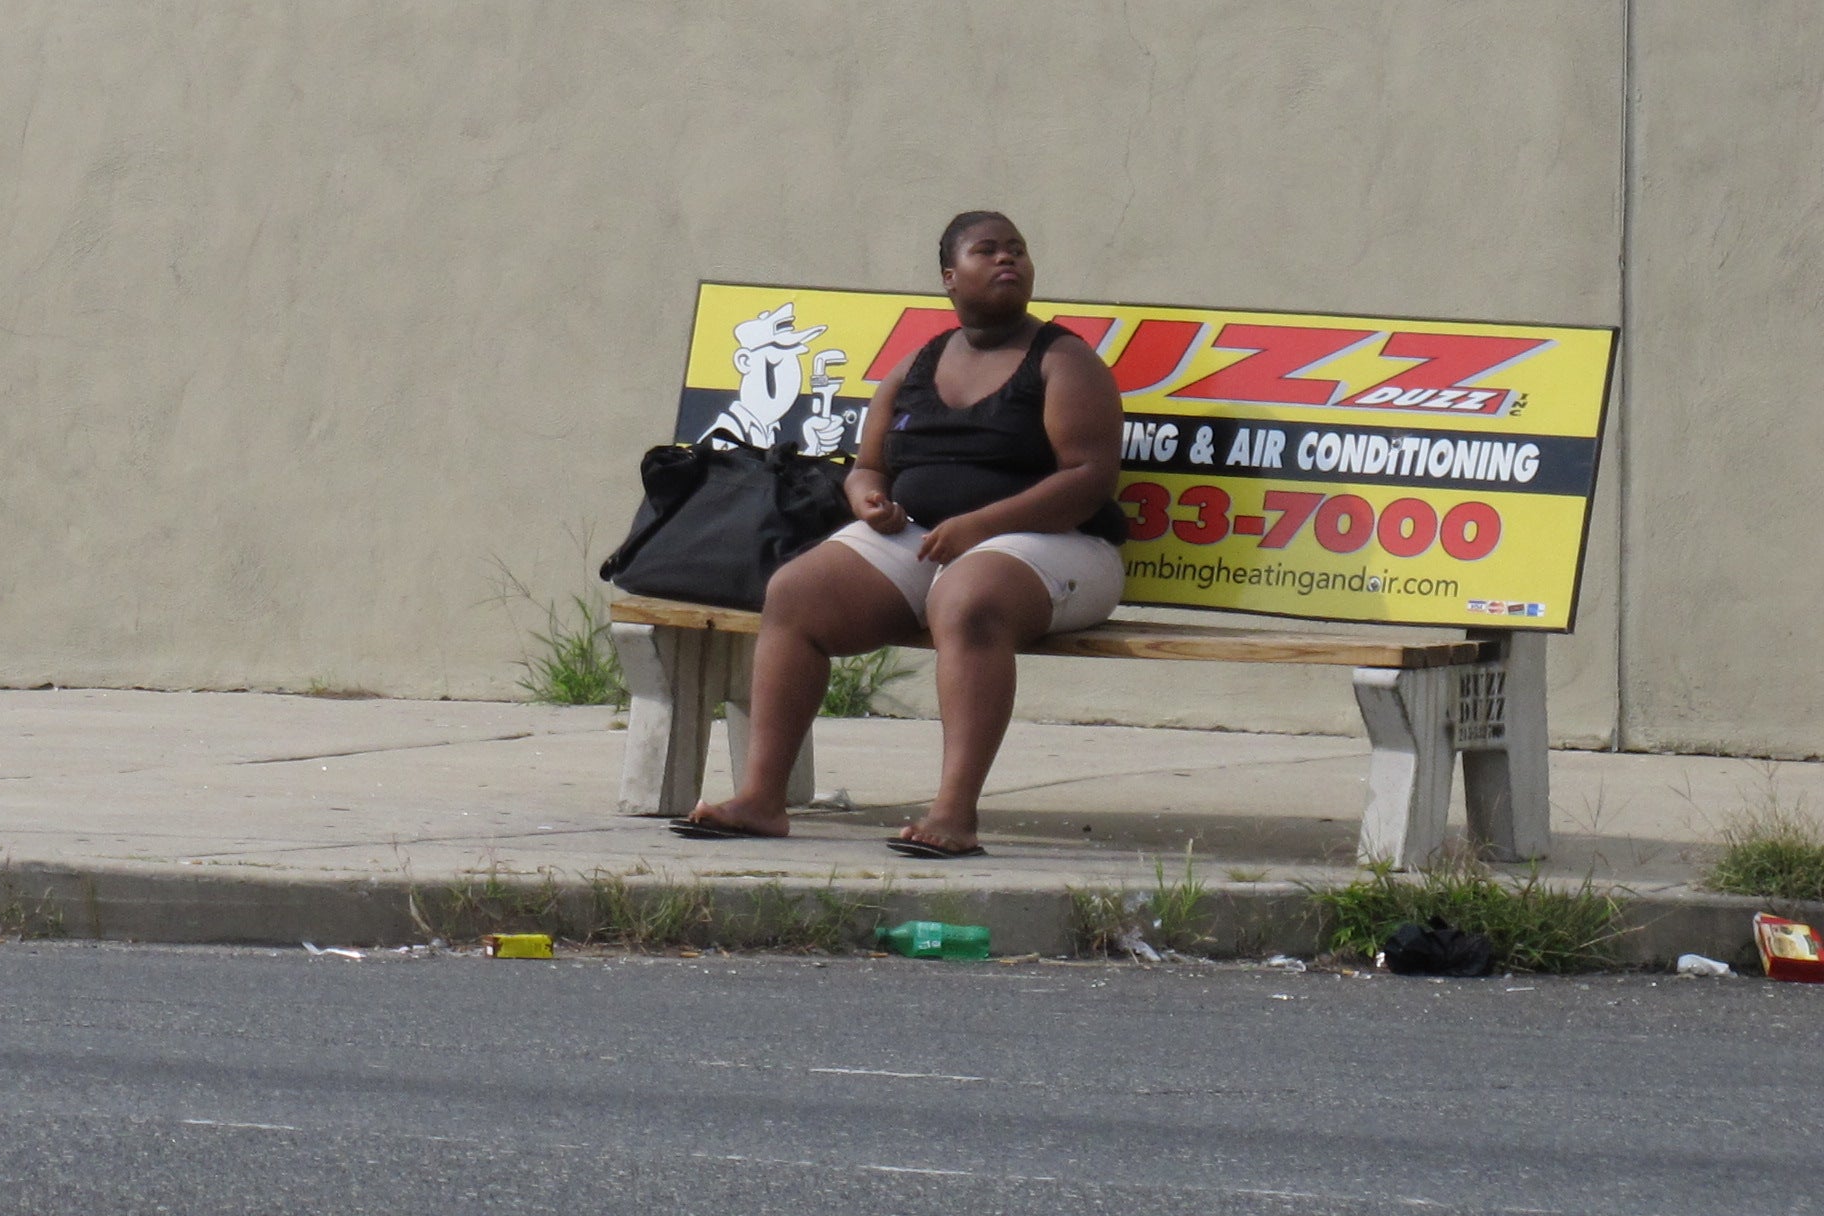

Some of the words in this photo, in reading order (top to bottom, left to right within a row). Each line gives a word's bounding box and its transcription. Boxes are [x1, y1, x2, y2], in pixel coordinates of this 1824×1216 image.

[1354, 386, 1498, 411] DUZZ
[1508, 392, 1530, 417] INC
[1189, 425, 1215, 465] &
[1225, 426, 1287, 469] AIR
[1297, 431, 1541, 483] CONDITIONING
[1118, 482, 1503, 561] 33-7000
